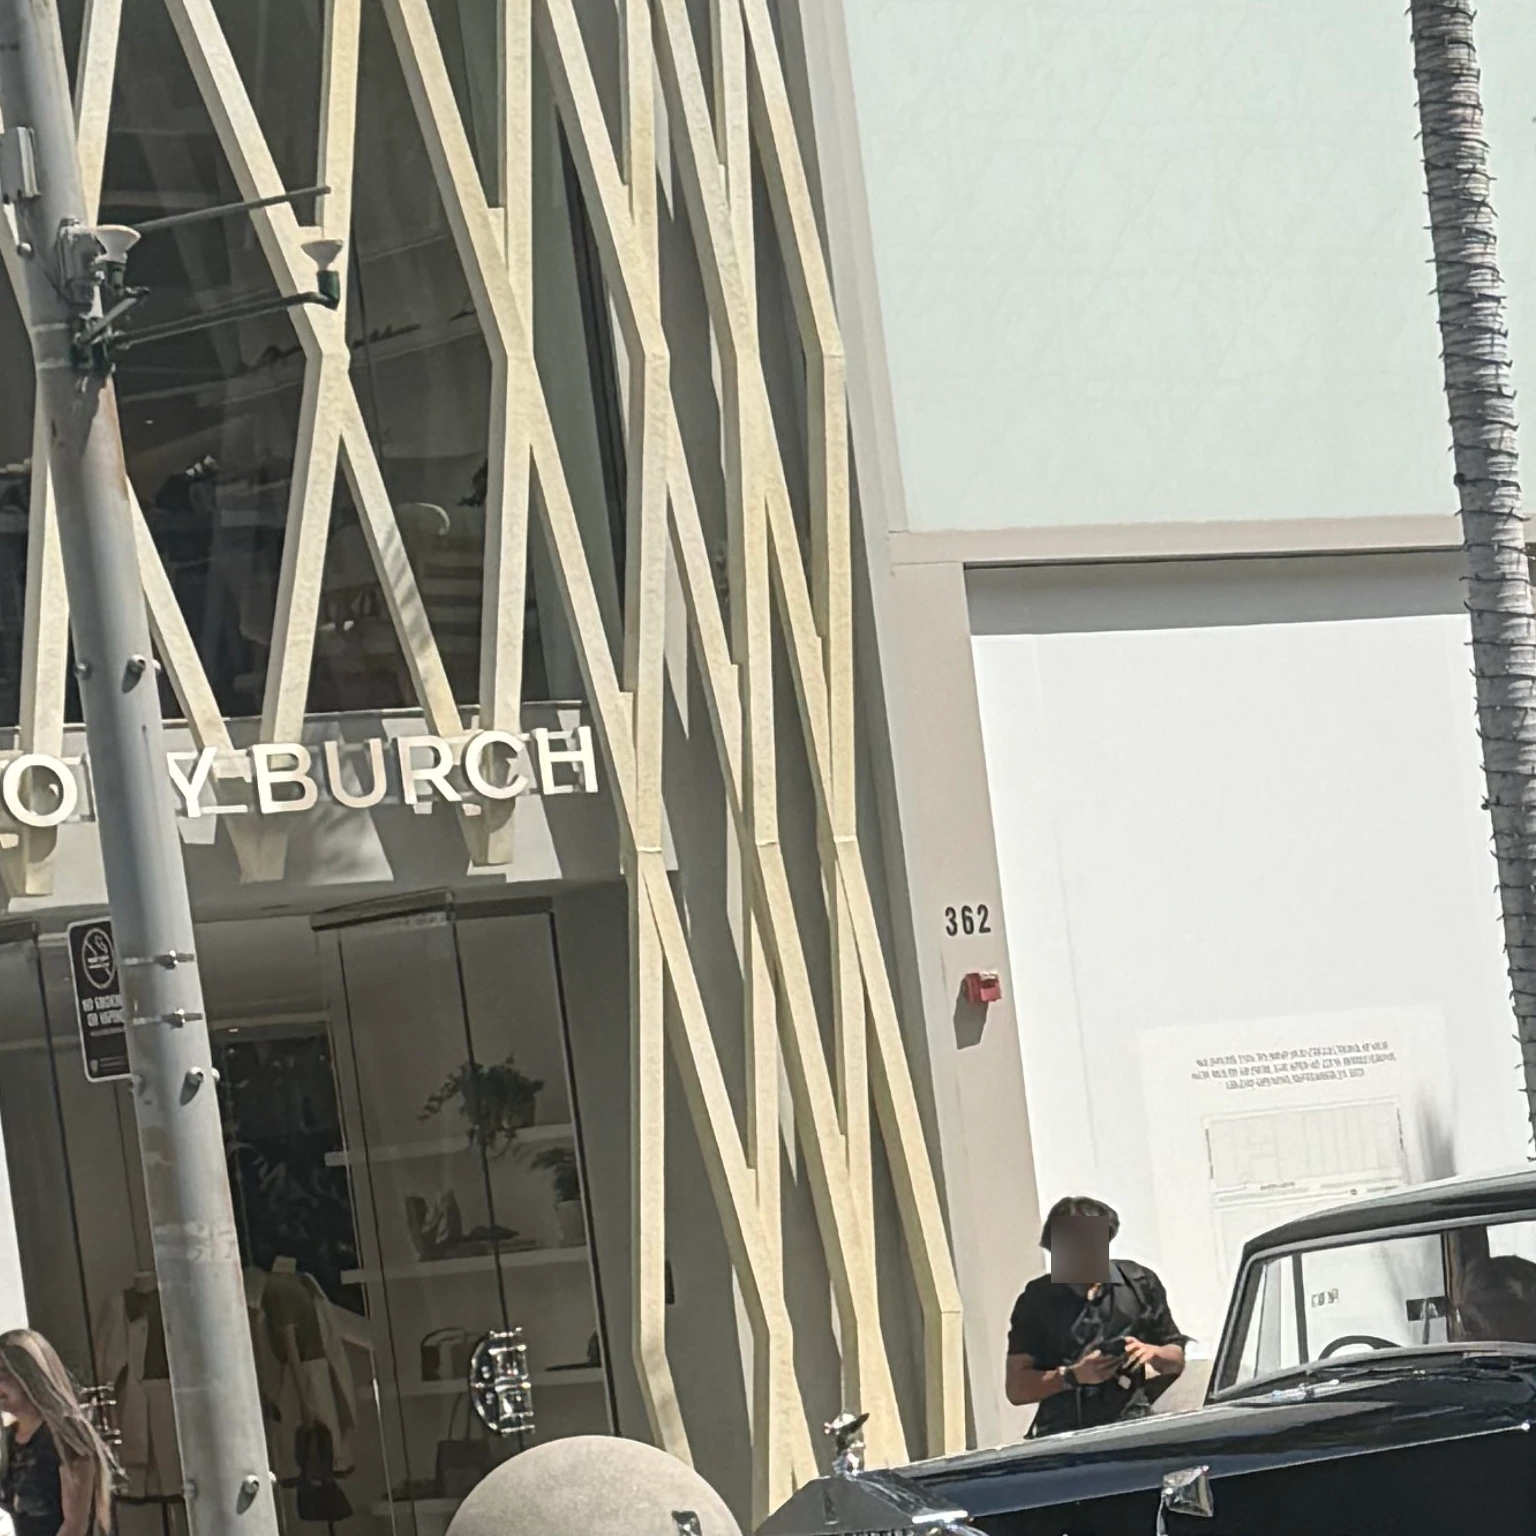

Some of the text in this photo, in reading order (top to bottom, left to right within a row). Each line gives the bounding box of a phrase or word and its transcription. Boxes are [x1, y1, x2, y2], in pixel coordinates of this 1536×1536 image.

[3, 725, 599, 828] OY BURCH
[944, 903, 991, 937] 362
